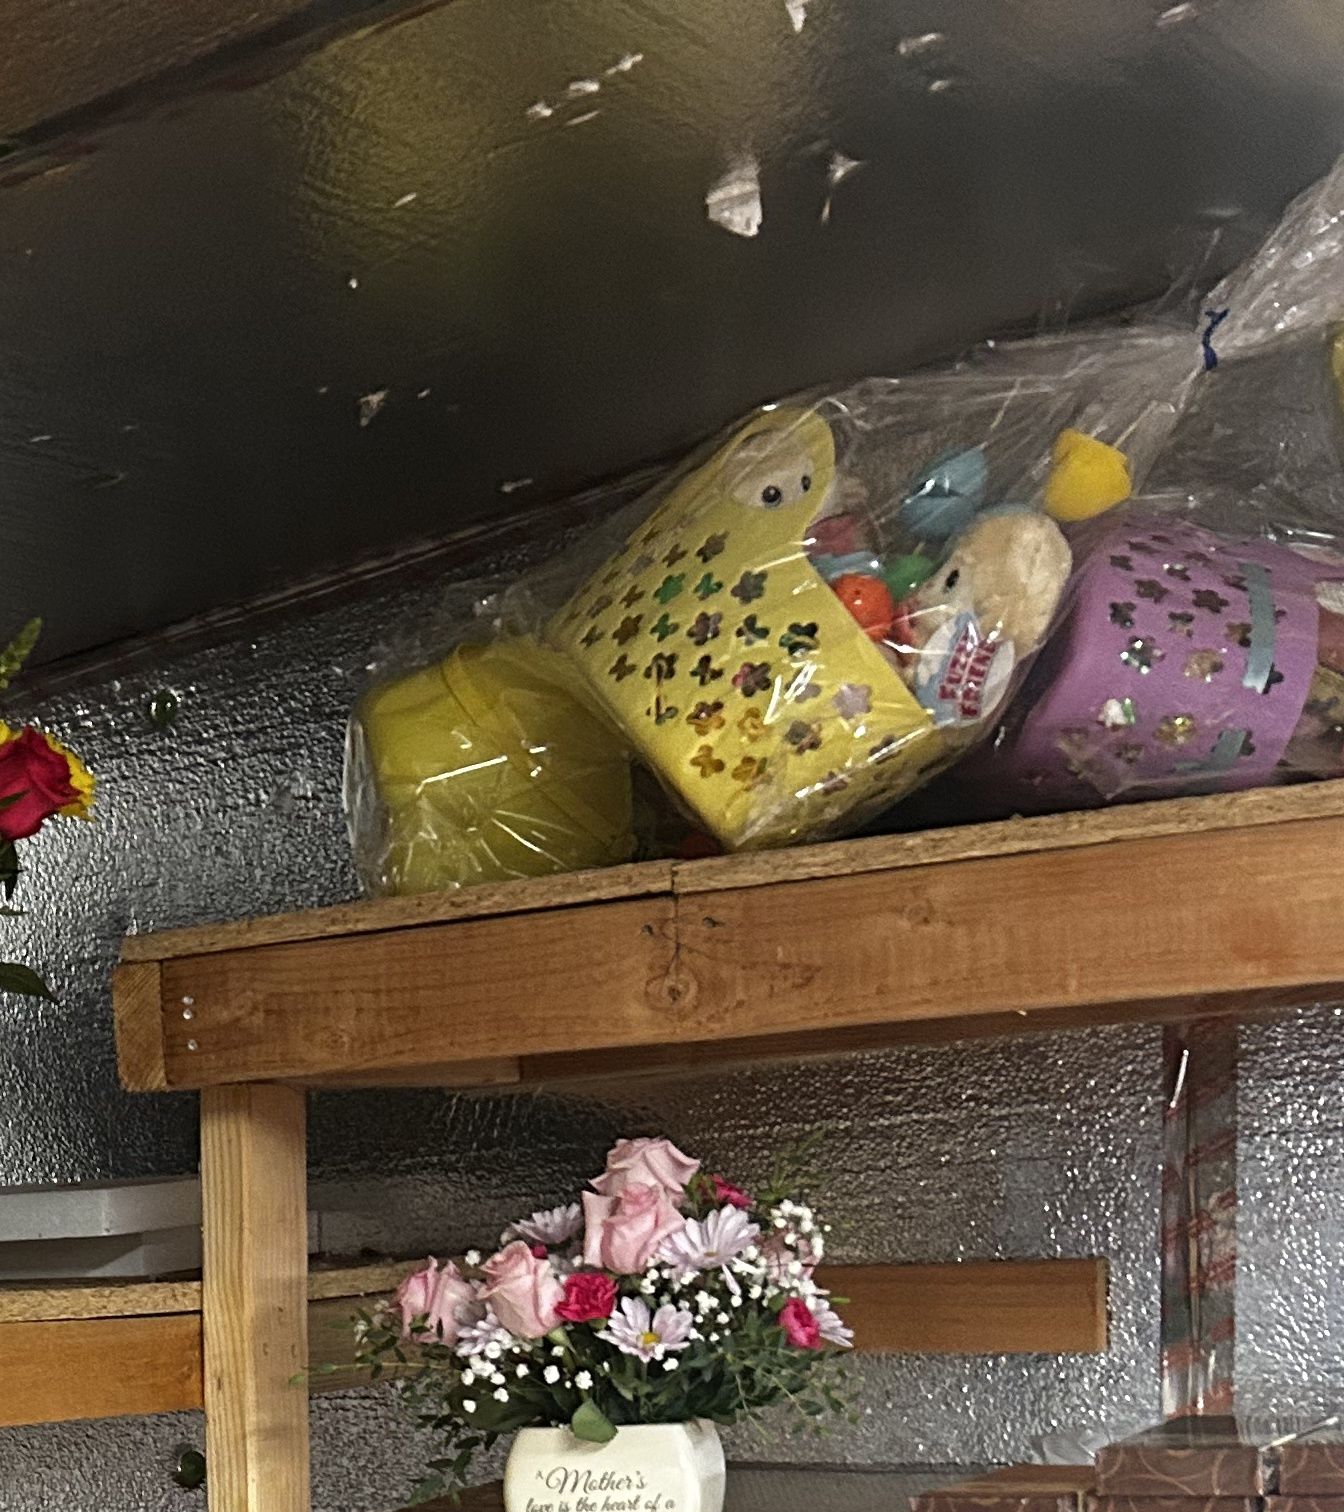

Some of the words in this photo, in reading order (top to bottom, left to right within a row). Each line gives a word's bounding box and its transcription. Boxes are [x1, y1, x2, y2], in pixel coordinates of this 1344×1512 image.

[545, 1466, 647, 1494] Mother's
[558, 1498, 571, 1512] is
[575, 1496, 597, 1512] the
[601, 1496, 639, 1512] heart
[665, 1498, 675, 1510] a
